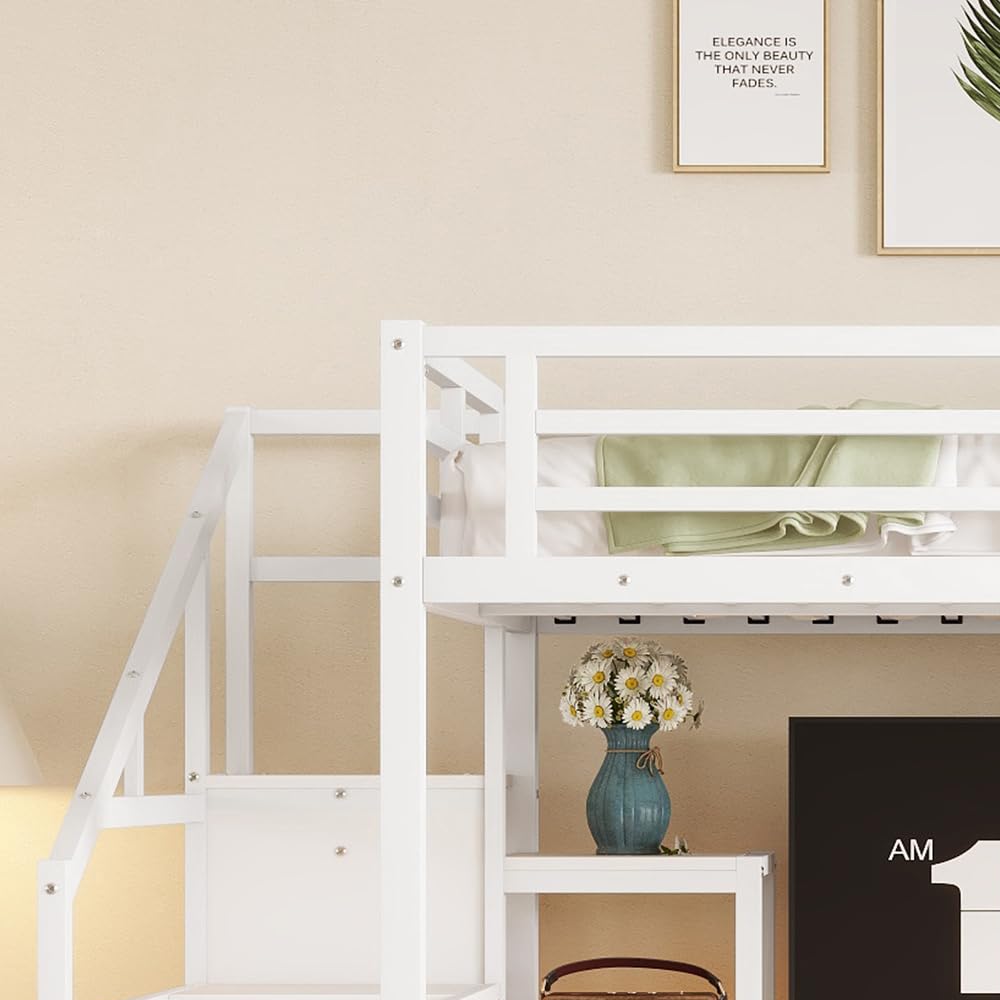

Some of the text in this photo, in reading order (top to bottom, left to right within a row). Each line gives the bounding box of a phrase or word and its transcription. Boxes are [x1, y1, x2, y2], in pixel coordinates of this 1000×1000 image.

[712, 37, 797, 47] ELEGANCE IS
[695, 51, 814, 61] THE ONLY BEAUTY
[714, 64, 795, 74] THAT NEVER
[732, 78, 777, 88] FADES.
[888, 838, 934, 861] AM
